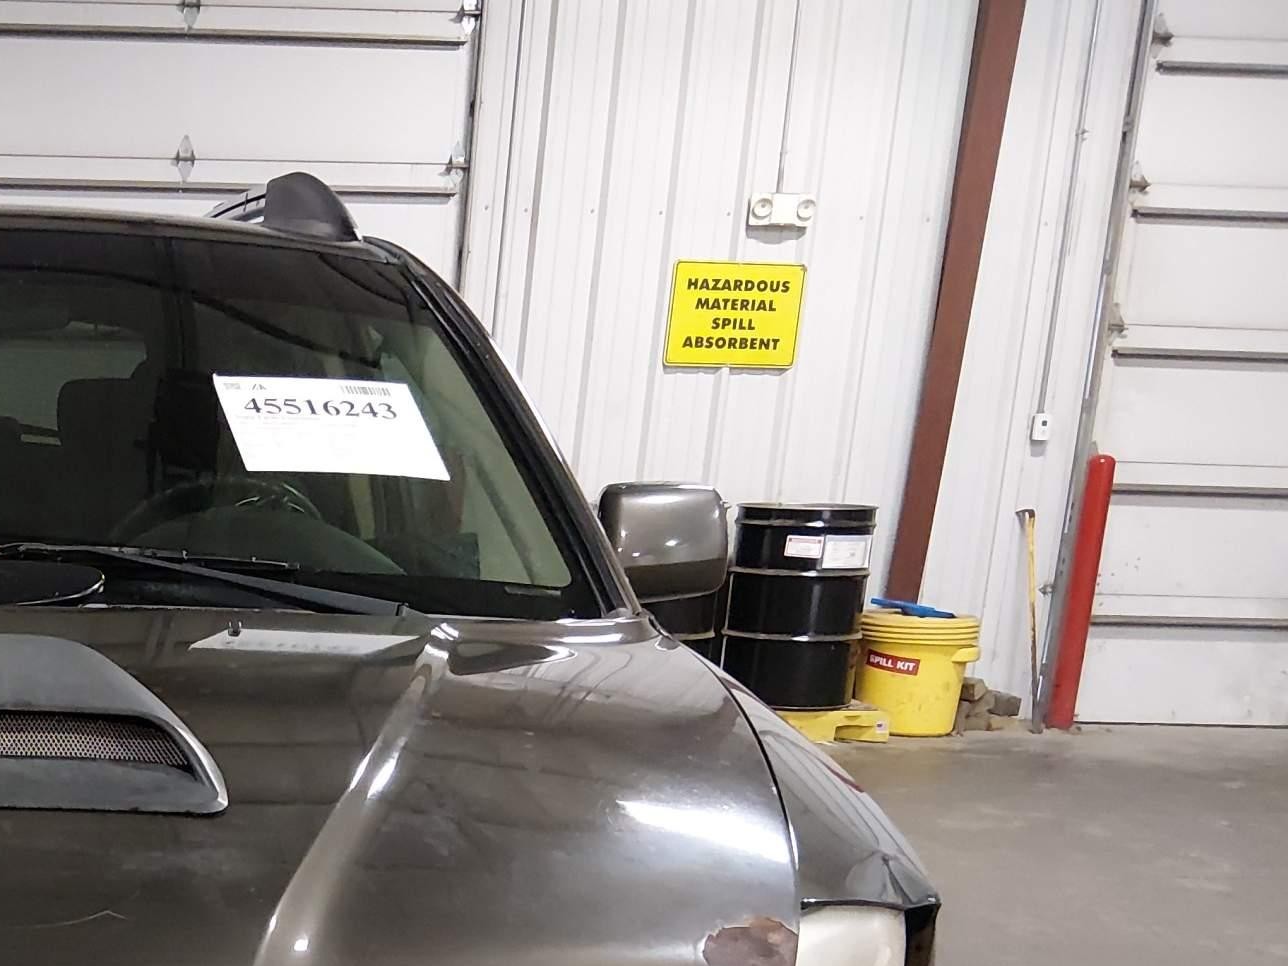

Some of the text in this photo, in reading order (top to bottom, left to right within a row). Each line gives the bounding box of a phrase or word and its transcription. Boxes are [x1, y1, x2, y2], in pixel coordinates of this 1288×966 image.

[687, 278, 790, 293] HAZARDOUS
[695, 298, 776, 312] MATERIAL
[711, 317, 756, 331] SPILL
[682, 336, 780, 350] ABSORBENT
[244, 397, 398, 420] 45516243
[869, 654, 916, 671] SPILL KIT
